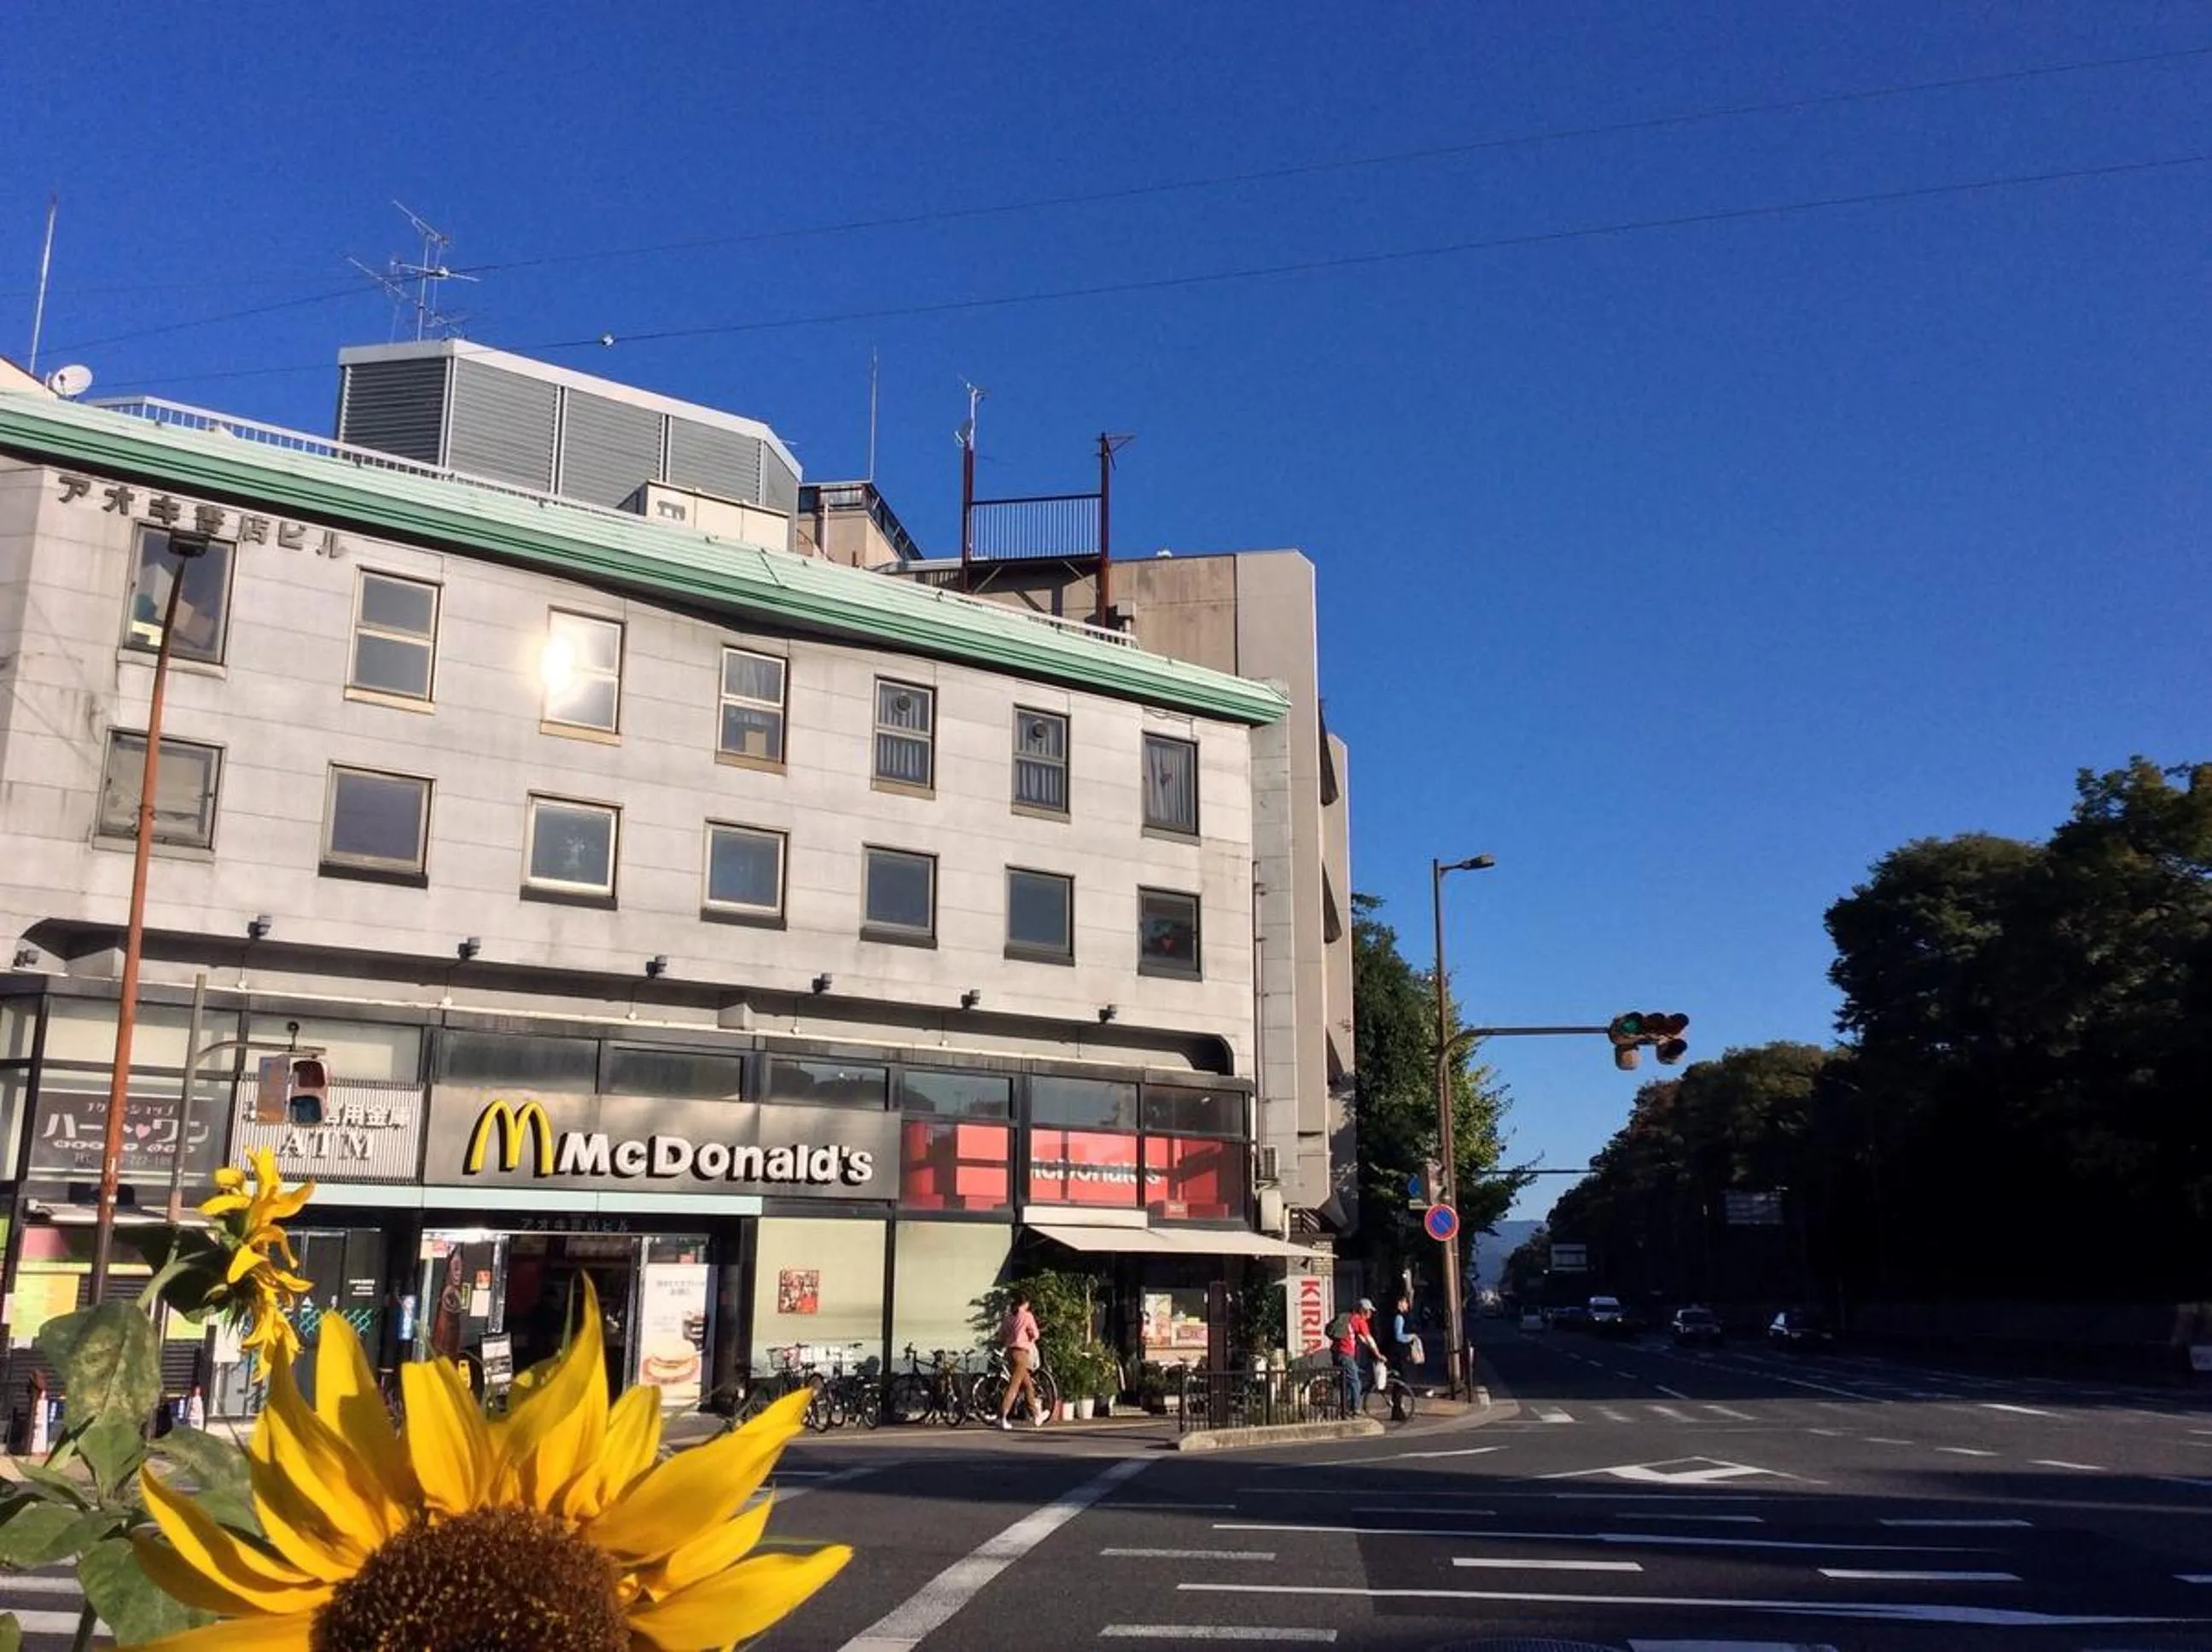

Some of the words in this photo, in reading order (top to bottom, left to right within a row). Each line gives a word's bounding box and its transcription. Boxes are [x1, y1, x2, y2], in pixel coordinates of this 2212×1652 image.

[58, 476, 348, 559] アオキ書店ビル
[279, 1129, 375, 1160] ATM
[558, 1131, 873, 1186] McDonald's
